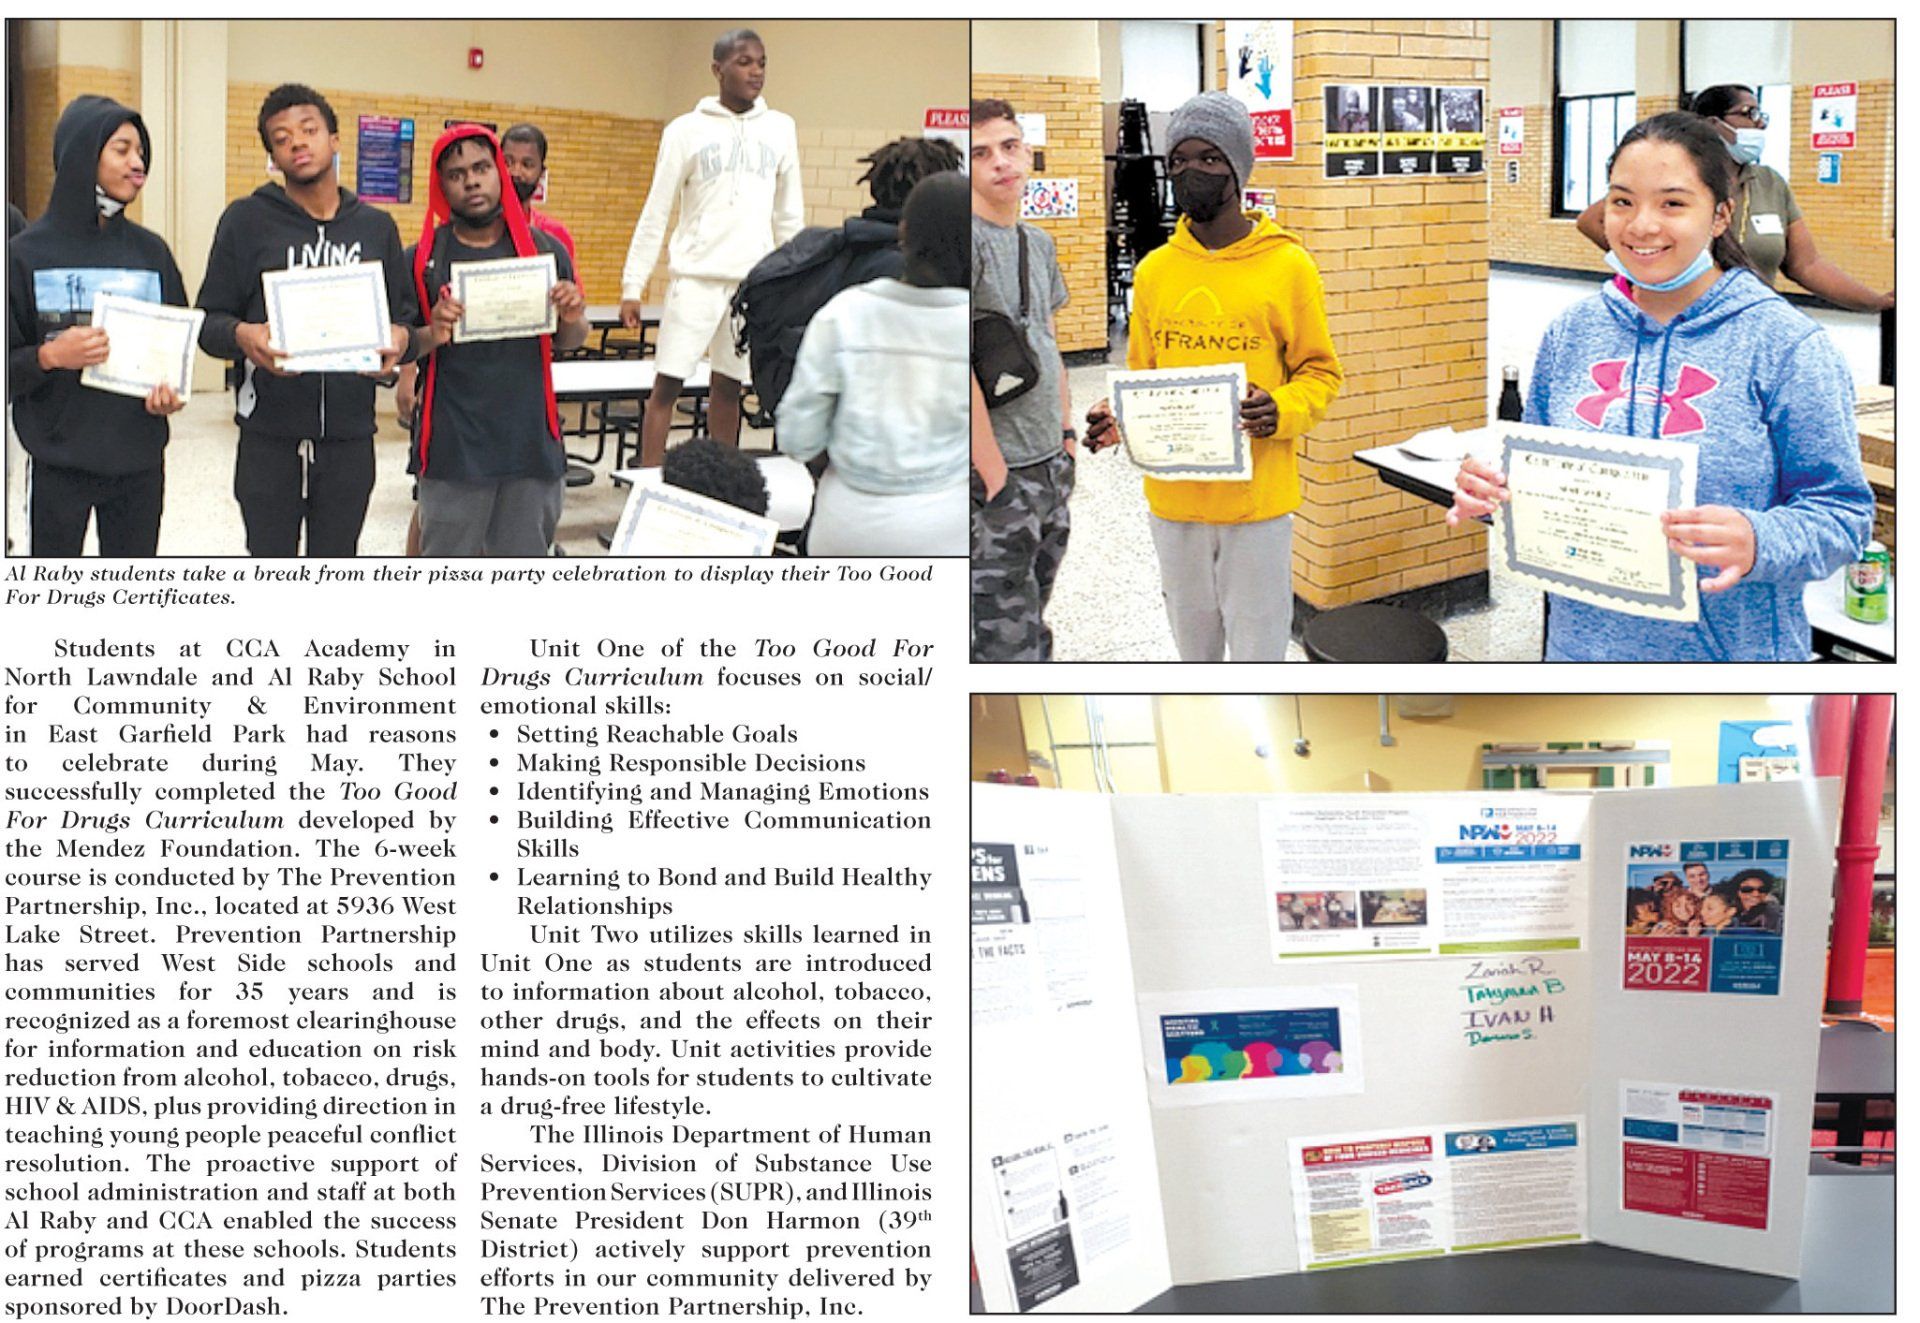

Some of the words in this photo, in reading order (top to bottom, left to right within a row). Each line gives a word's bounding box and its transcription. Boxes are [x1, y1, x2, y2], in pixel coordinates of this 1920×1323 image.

[700, 142, 777, 180] GAP
[287, 241, 362, 270] LIVING
[5, 565, 25, 581] Al
[34, 566, 83, 584] Raby
[91, 565, 175, 581] students
[184, 565, 226, 581] take
[234, 571, 244, 581] a
[255, 565, 310, 581] break
[315, 565, 363, 584] from
[374, 565, 422, 581] their
[429, 566, 482, 584] pizza
[492, 569, 545, 584] party
[553, 565, 665, 581] celebration
[675, 569, 692, 581] to
[701, 565, 773, 584] display
[782, 565, 830, 581] their
[838, 566, 871, 581] Too
[880, 565, 932, 581] Good
[6, 590, 40, 604] For
[47, 590, 105, 607] Drugs
[113, 588, 234, 608] Certificates.
[55, 639, 154, 657] Students
[180, 643, 201, 657] at
[227, 640, 279, 656] CCA
[305, 639, 409, 661] Academy
[435, 640, 455, 656] in
[532, 639, 580, 657] Unit
[598, 640, 644, 657] One
[662, 638, 684, 656] of
[701, 639, 736, 657] the
[755, 639, 795, 656] Too
[814, 639, 876, 657] Good
[894, 639, 934, 656] For
[6, 667, 70, 685] North
[89, 667, 197, 685] Lawndale
[212, 667, 253, 685] and
[269, 667, 290, 685] Al
[309, 667, 363, 690] Raby
[380, 667, 455, 685] School
[6, 726, 25, 742] in
[50, 725, 97, 743] East
[120, 724, 211, 743] Garfield
[235, 724, 284, 742] Park
[307, 724, 347, 742] had
[370, 730, 456, 742] reasons
[518, 725, 598, 747] Setting
[608, 724, 723, 742] Reachable
[733, 724, 797, 743] Goals
[519, 781, 642, 804] Identifying
[651, 782, 691, 800] and
[701, 782, 810, 804] Managing
[820, 782, 928, 800] Emotions
[7, 811, 47, 828] For
[62, 811, 130, 832] Drugs
[146, 810, 283, 828] Curriculum
[299, 810, 413, 833] developed
[430, 810, 456, 833] by
[518, 868, 620, 889] Learning
[628, 871, 649, 885] to
[659, 867, 716, 885] Bond
[725, 867, 765, 885] and
[775, 867, 833, 885] Build
[842, 867, 931, 890] Healthy
[6, 896, 146, 919] Partnership,
[157, 897, 206, 916] Inc.,
[216, 896, 298, 914] located
[307, 900, 328, 914] at
[337, 897, 394, 914] 5936
[402, 897, 456, 914] West
[481, 954, 530, 972] Unit
[545, 953, 592, 972] One
[607, 960, 629, 971] as
[645, 953, 741, 971] students
[756, 960, 791, 971] are
[807, 953, 931, 971] introduced
[1628, 953, 1661, 962] MAY
[1664, 953, 1702, 963] 8-14
[1628, 963, 1701, 985] 2022
[6, 983, 155, 1000] communities
[180, 981, 212, 1000] for
[236, 982, 262, 1000] 35
[289, 988, 348, 1005] years
[373, 982, 414, 1000] and
[439, 983, 456, 1000] is
[481, 1010, 543, 1029] other
[557, 1010, 625, 1033] drugs,
[641, 1010, 681, 1029] and
[697, 1010, 732, 1029] the
[746, 1010, 820, 1029] effects
[834, 1017, 861, 1029] on
[877, 1011, 932, 1029] their
[1462, 1009, 1530, 1030] IVAN
[6, 1068, 115, 1086] reduction
[124, 1067, 176, 1086] from
[184, 1067, 274, 1086] alcohol,
[284, 1068, 378, 1086] tobacco,
[387, 1068, 455, 1091] drugs,
[5, 1153, 128, 1172] resolution.
[147, 1154, 190, 1172] The
[207, 1155, 314, 1176] proactive
[332, 1157, 418, 1176] support
[435, 1153, 457, 1171] of
[481, 1154, 582, 1172] Services,
[603, 1154, 695, 1171] Division
[716, 1153, 738, 1171] of
[756, 1154, 871, 1172] Substance
[892, 1154, 931, 1172] Use
[5, 1211, 27, 1229] Al
[41, 1211, 96, 1234] Raby
[107, 1211, 147, 1229] and
[160, 1212, 212, 1229] CCA
[224, 1211, 312, 1229] enabled
[324, 1211, 359, 1229] the
[372, 1217, 456, 1229] success
[6, 1297, 121, 1319] sponsored
[131, 1297, 157, 1319] by
[168, 1297, 287, 1315] DoorDash.
